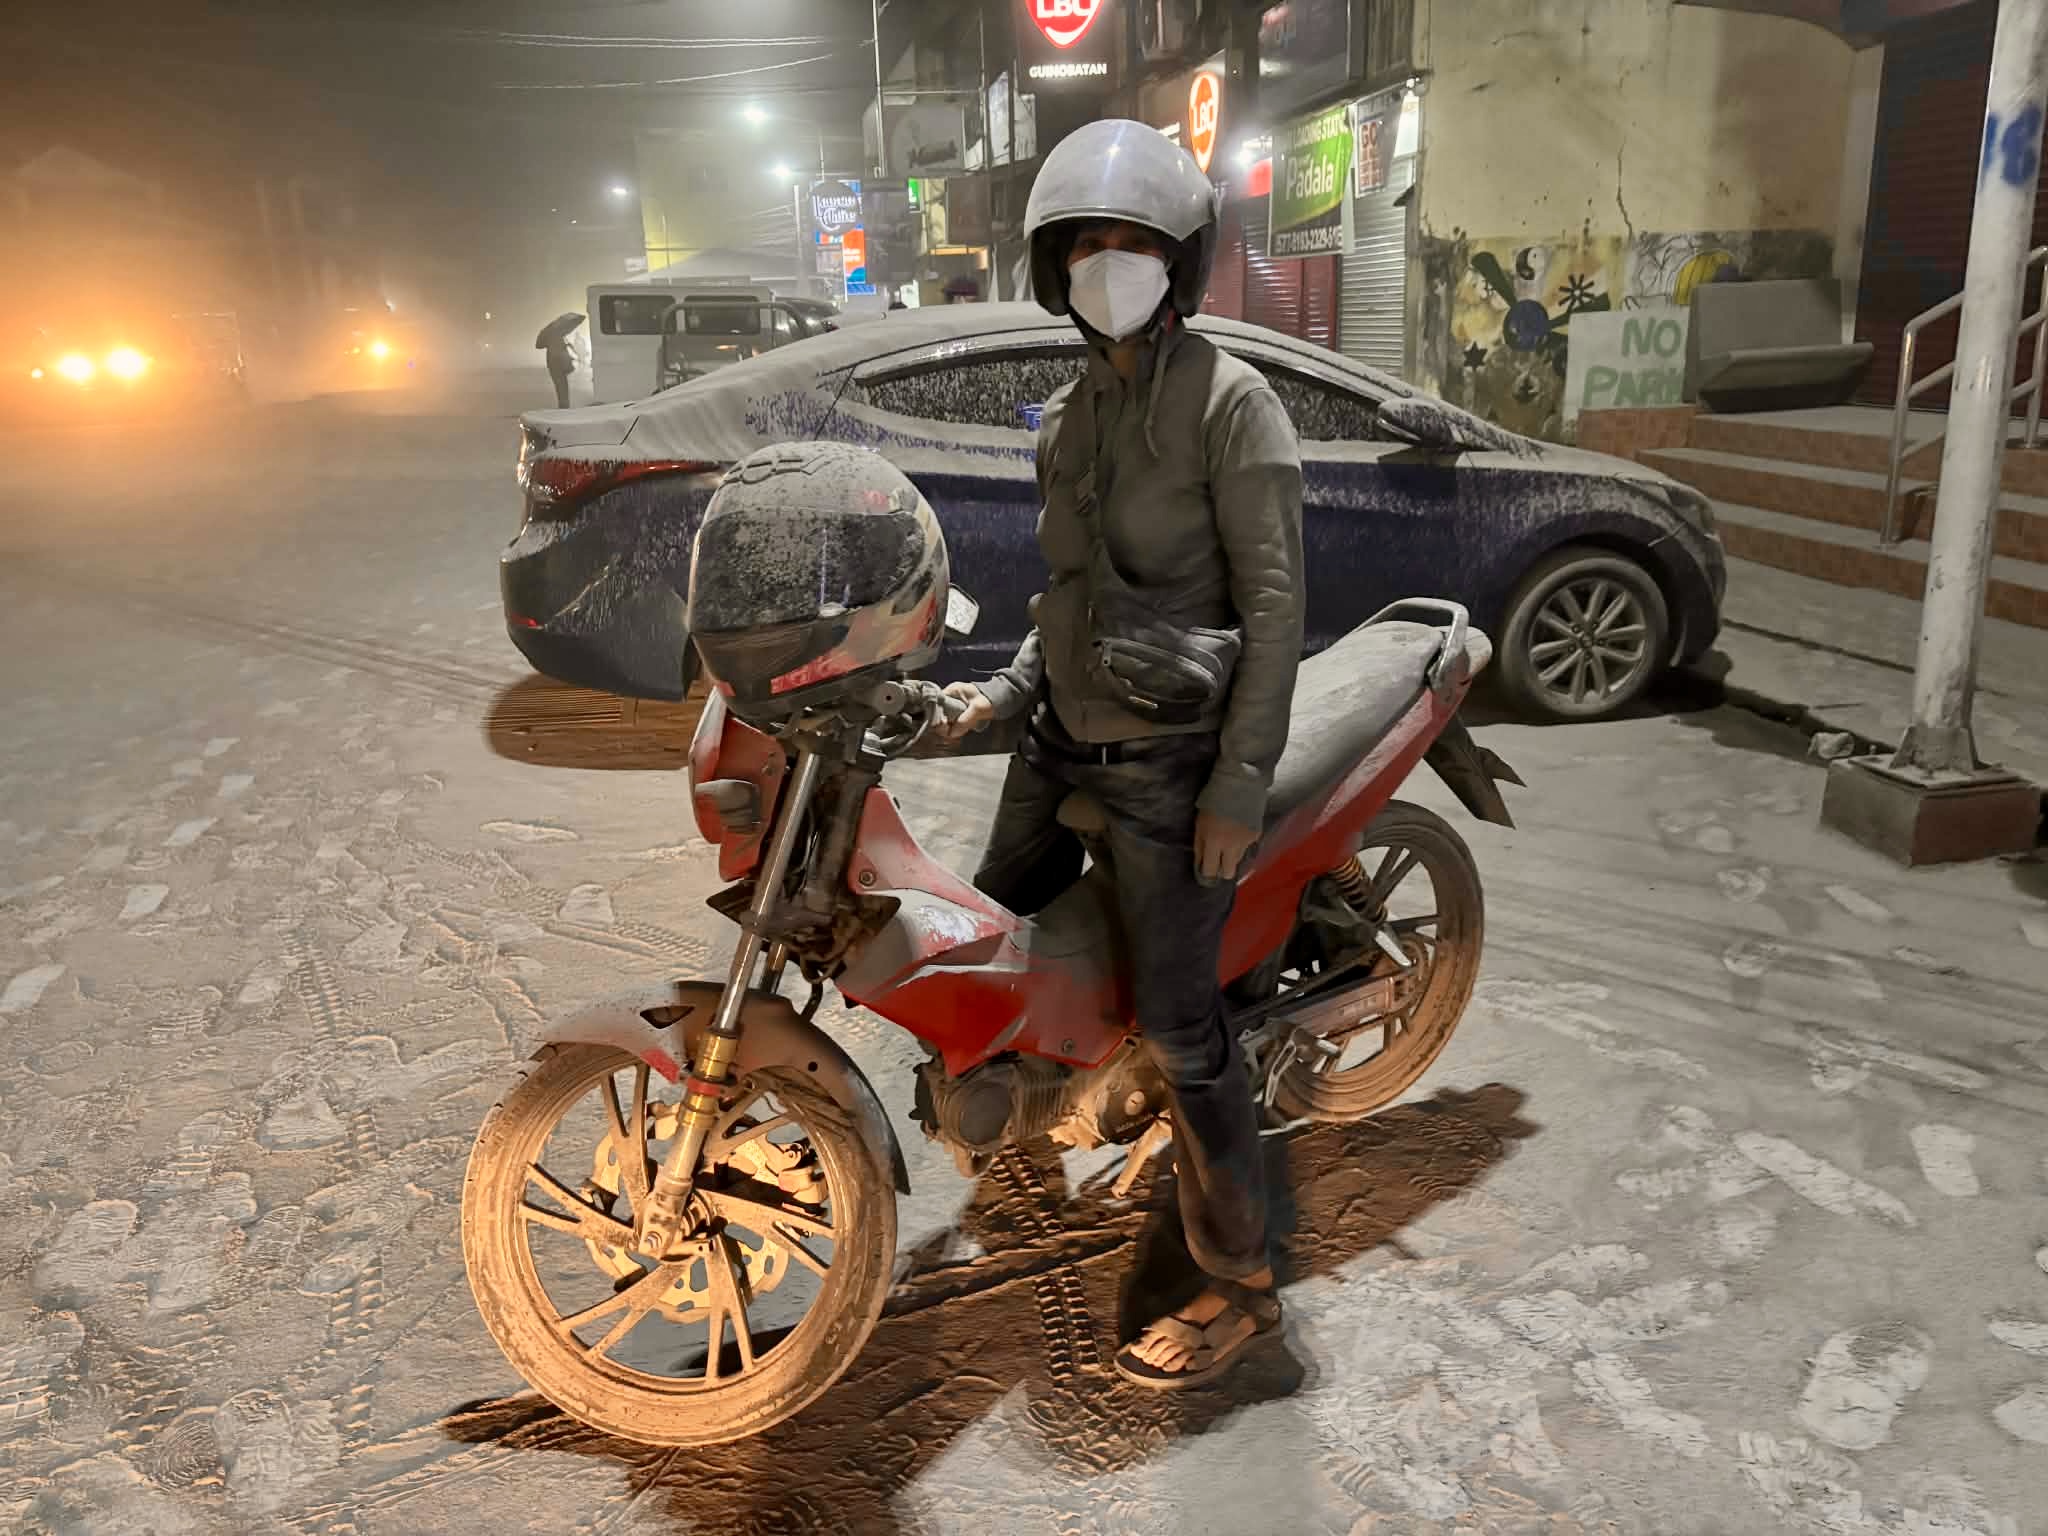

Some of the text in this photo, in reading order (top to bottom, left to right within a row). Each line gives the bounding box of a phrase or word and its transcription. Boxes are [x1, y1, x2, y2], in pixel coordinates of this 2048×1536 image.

[1029, 64, 1107, 78] GUINOBATAN
[1286, 153, 1334, 200] Padala
[1621, 317, 1681, 358] NO
